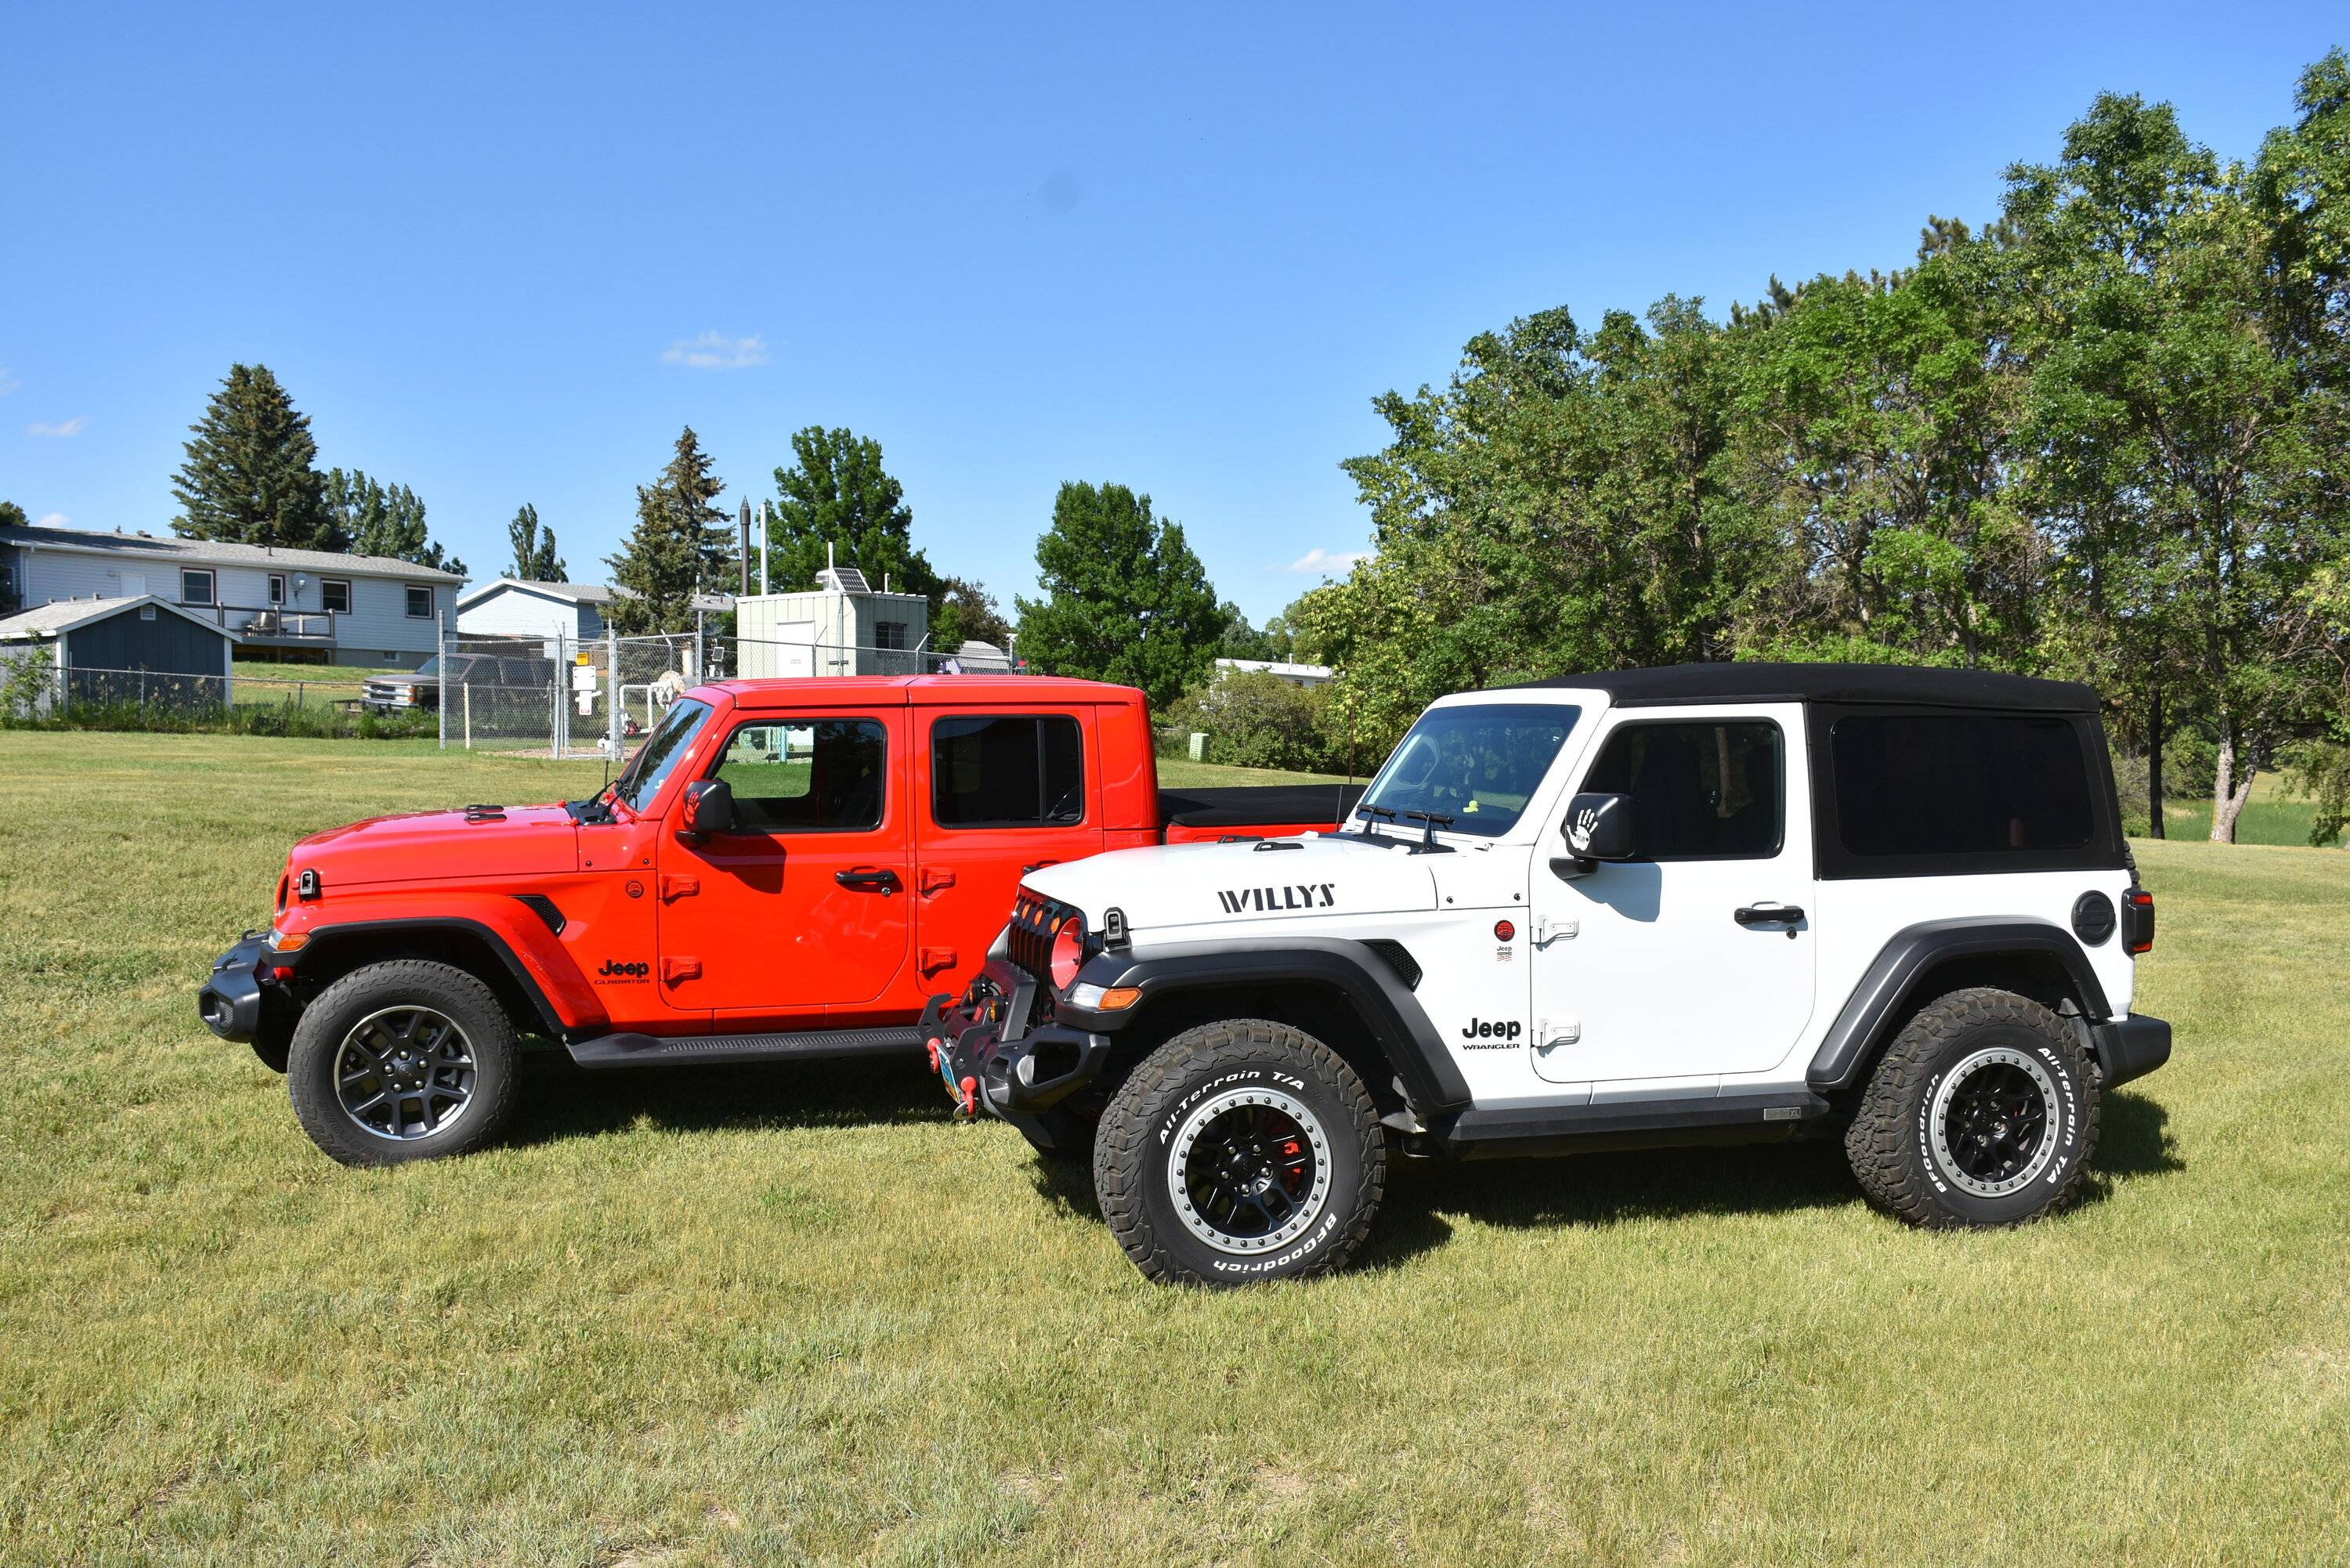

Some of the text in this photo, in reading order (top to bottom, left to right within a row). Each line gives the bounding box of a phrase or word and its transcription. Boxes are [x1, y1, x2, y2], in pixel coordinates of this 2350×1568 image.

[1217, 883, 1335, 913] WILLYS
[598, 959, 649, 978] Jeep
[1462, 1017, 1521, 1041] Jeep
[1159, 1070, 1305, 1145] All-Terrain T/A
[1919, 1074, 1947, 1194] BFGoodrich
[2037, 1047, 2076, 1184] All-Terrain T/A
[1213, 1212, 1337, 1274] BFGoodrich
